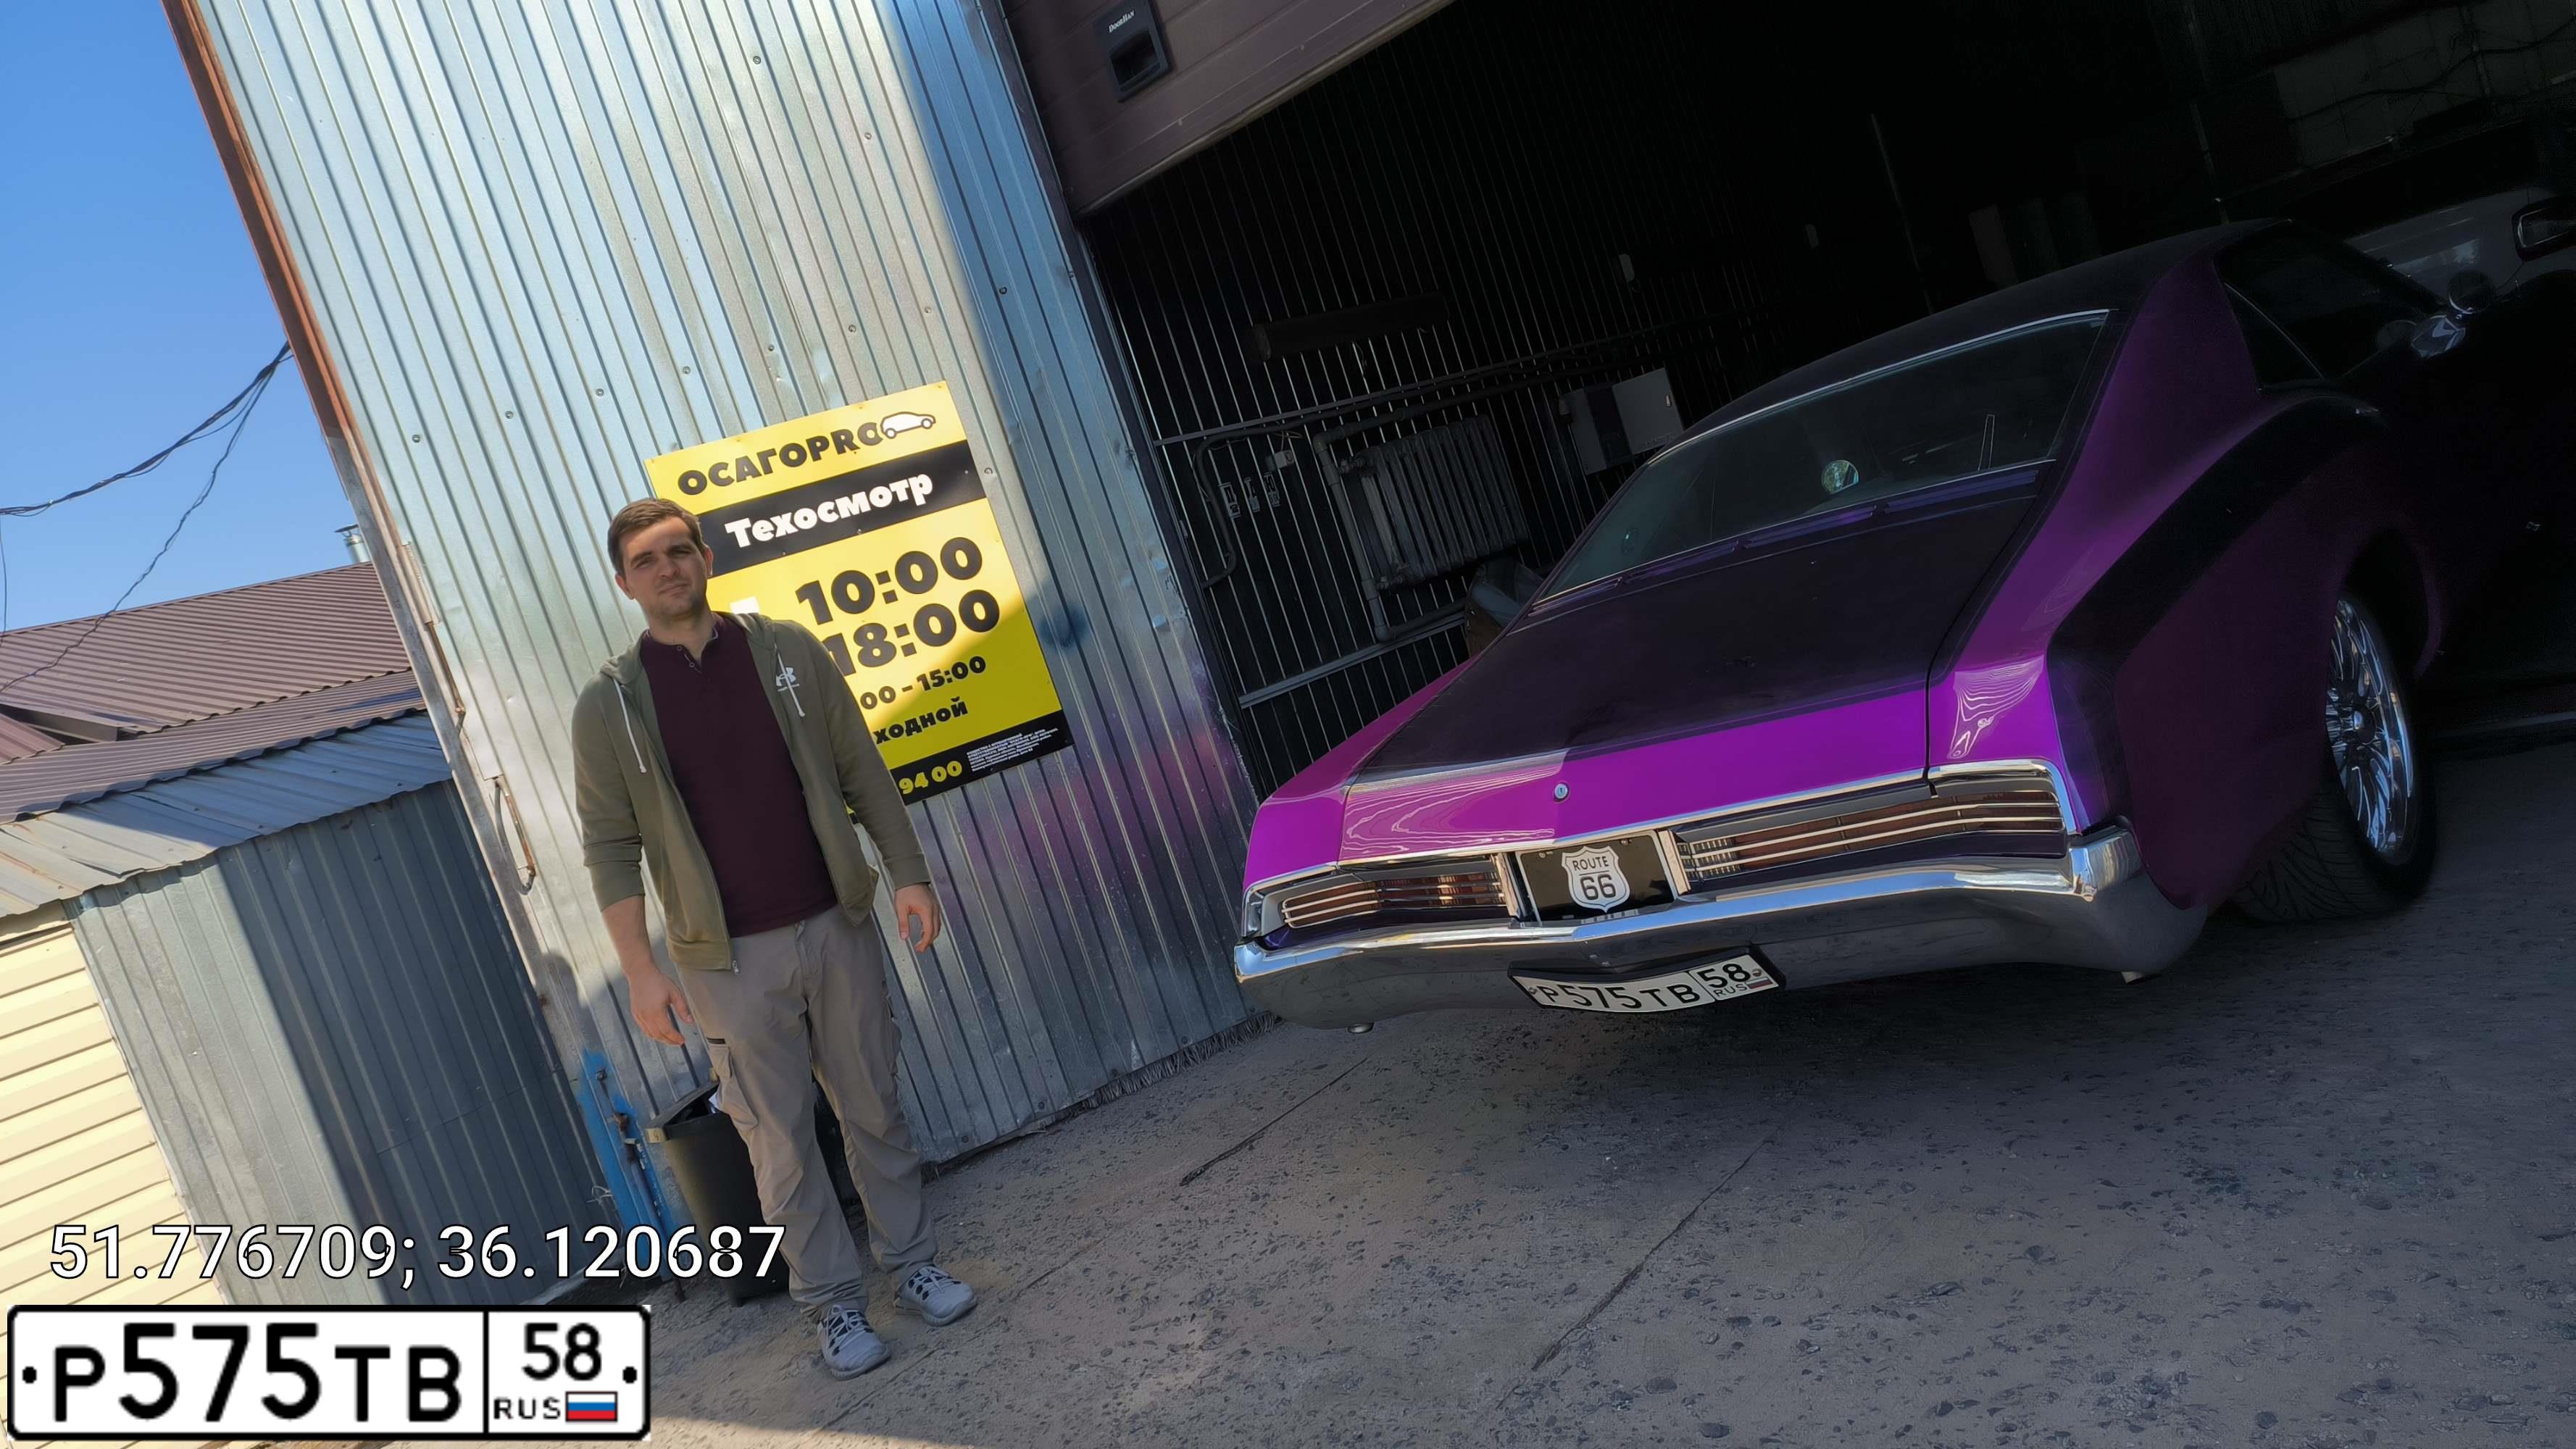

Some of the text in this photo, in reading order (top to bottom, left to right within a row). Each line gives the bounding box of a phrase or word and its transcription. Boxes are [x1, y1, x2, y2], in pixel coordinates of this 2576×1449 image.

[725, 474, 933, 548] Техосмотр
[795, 537, 983, 625] 10:00
[822, 589, 1000, 677] 18:00
[860, 685, 896, 710] 00
[917, 656, 986, 691] 15:00
[872, 696, 968, 745] ходной
[899, 761, 962, 795] 94 00
[1572, 856, 1609, 872] ROUTE
[1580, 874, 1617, 901] 66
[1697, 964, 1751, 988] 58
[1713, 983, 1748, 998] RUS
